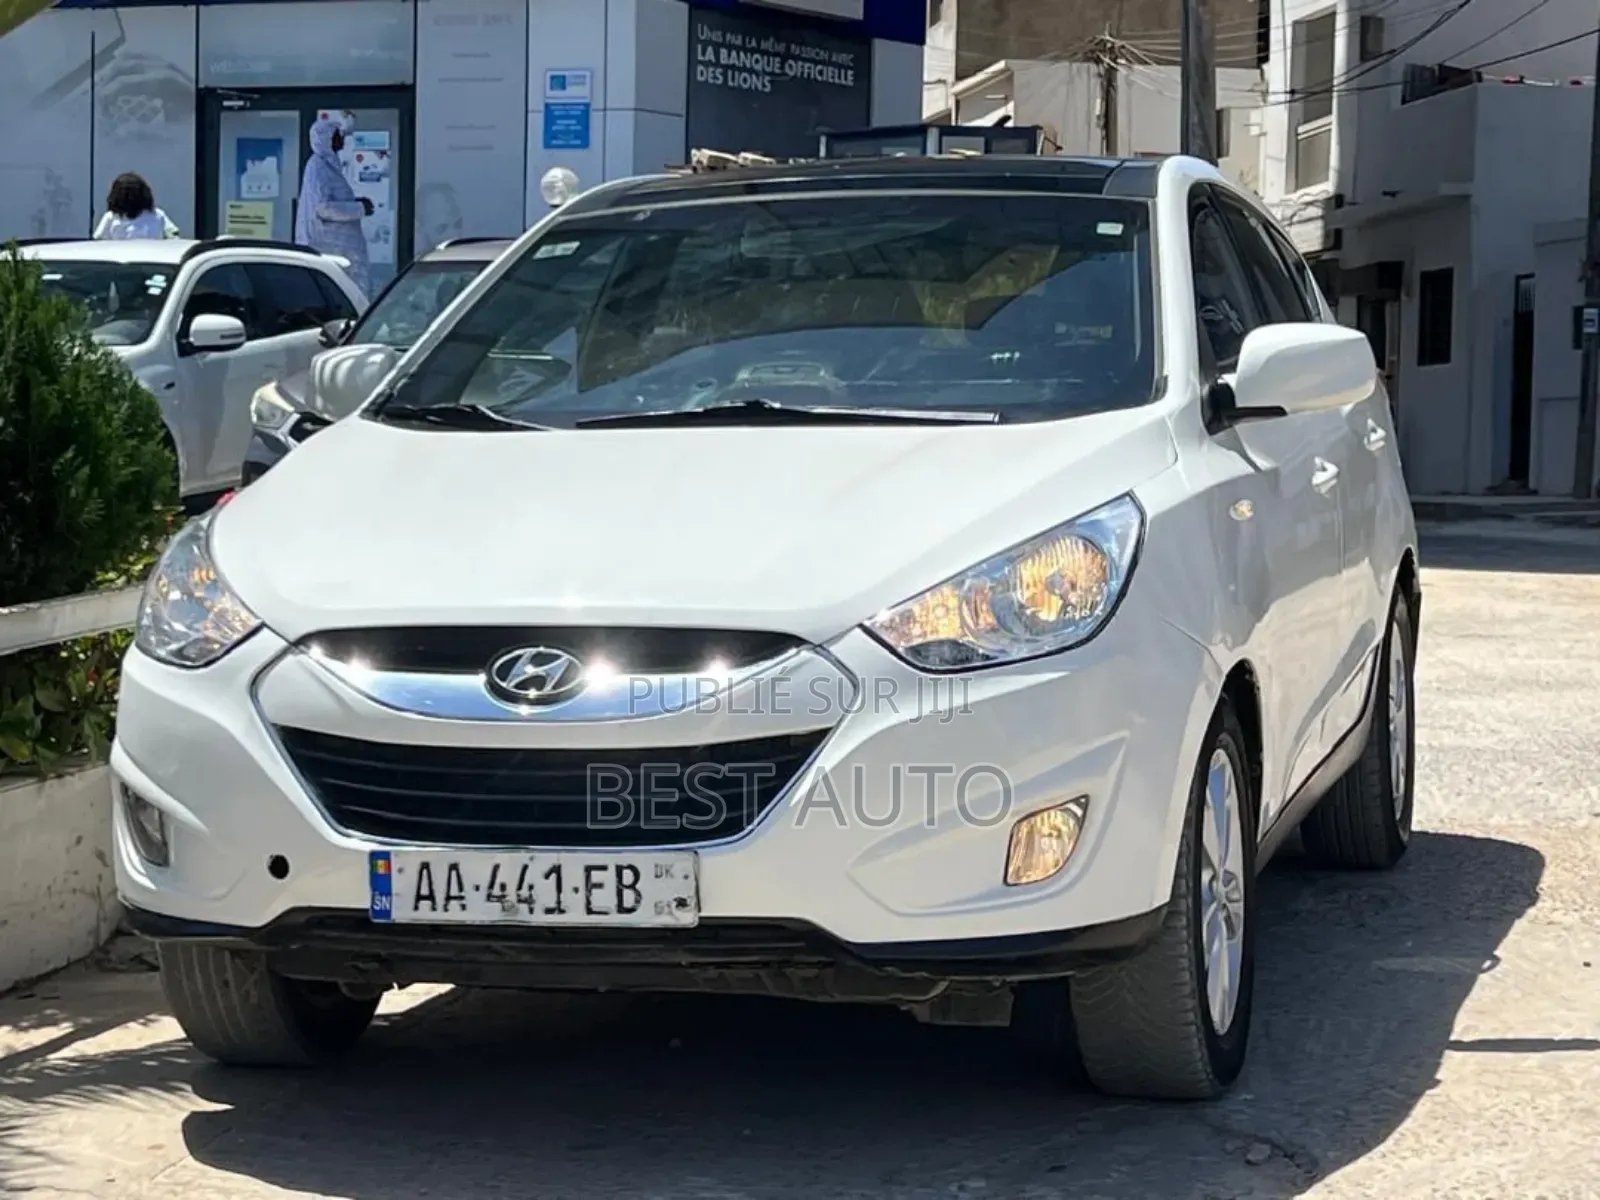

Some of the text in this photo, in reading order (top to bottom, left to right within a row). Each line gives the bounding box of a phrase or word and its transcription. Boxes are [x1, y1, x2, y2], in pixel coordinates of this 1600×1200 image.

[745, 36, 758, 48] LA
[696, 44, 855, 87] LA BANQUE OFFICIELLE
[696, 66, 772, 93] DES LIONS
[654, 862, 675, 879] DK
[373, 892, 391, 911] SN
